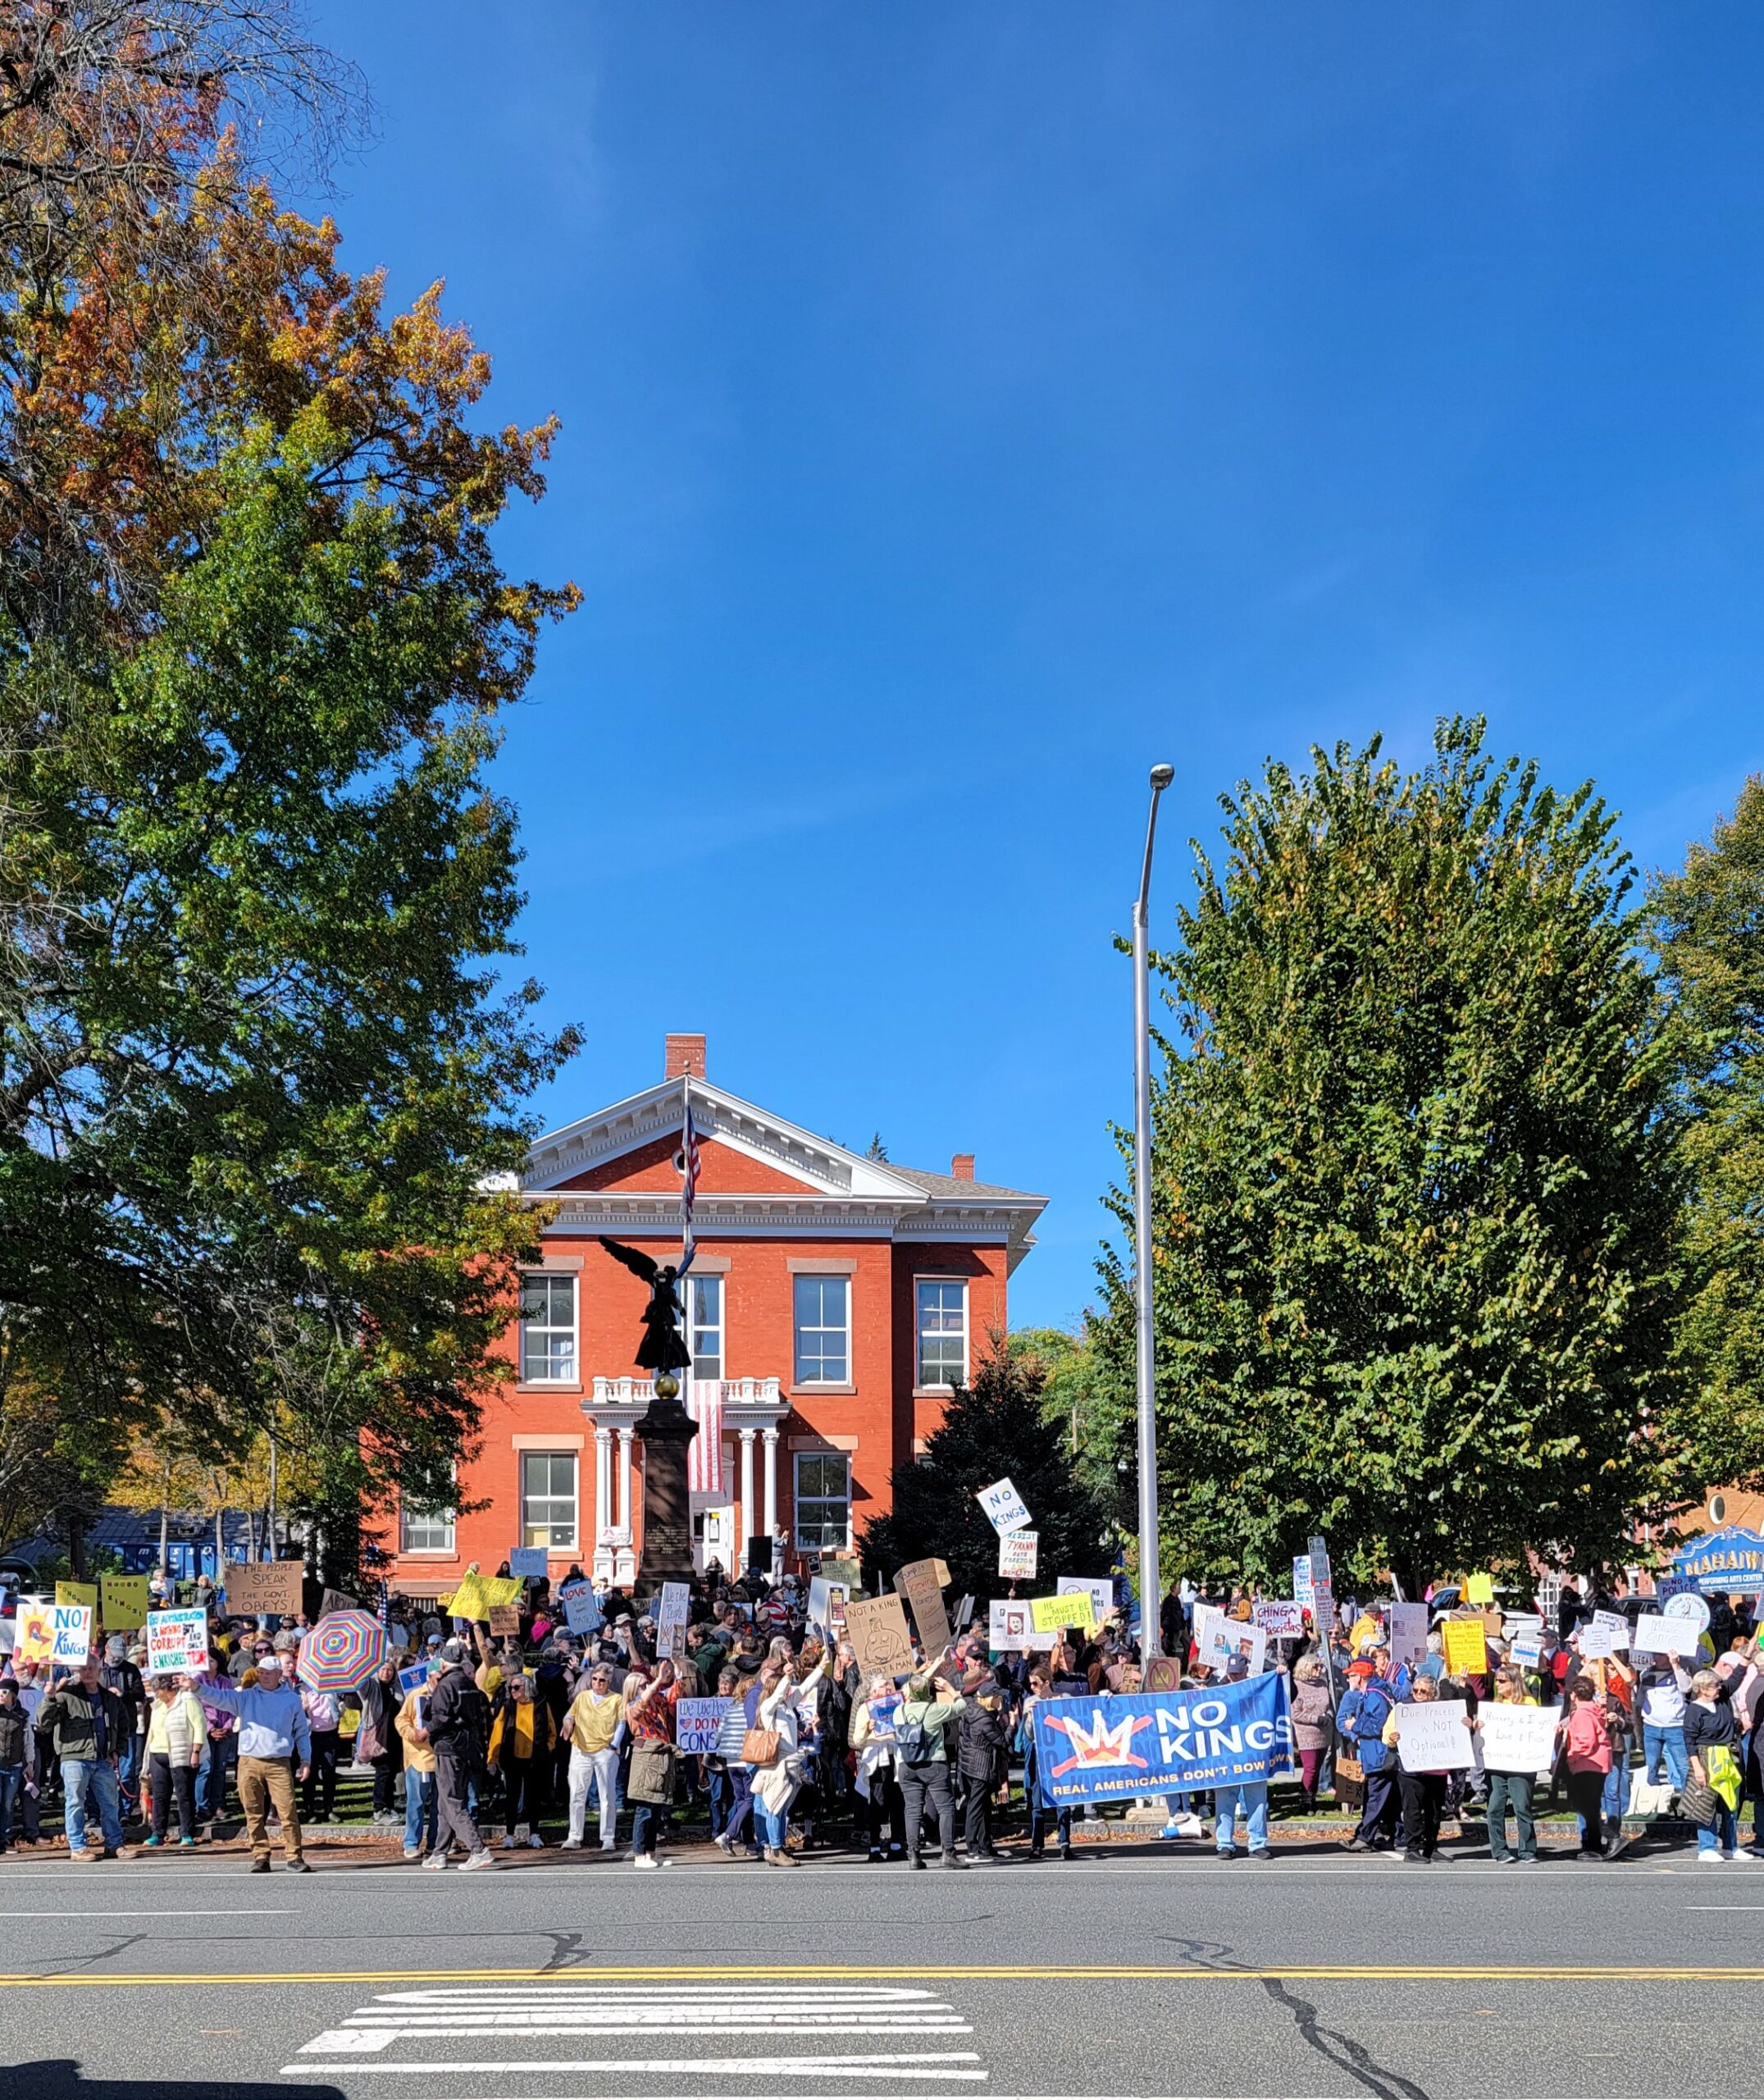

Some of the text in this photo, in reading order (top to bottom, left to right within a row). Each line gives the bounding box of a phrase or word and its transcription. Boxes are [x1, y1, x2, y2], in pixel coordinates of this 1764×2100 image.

[989, 1490, 1012, 1508] NO
[991, 1505, 1026, 1527] KINGS
[242, 1563, 295, 1574] THE PEOPLE
[1002, 1568, 1035, 1577] DOMESTIC
[251, 1573, 289, 1586] SPEAK
[1698, 1573, 1763, 1585] PERFORMING ARTS CENTER
[263, 1589, 291, 1598] GOVT.
[565, 1586, 586, 1600] LOVE
[1662, 1584, 1696, 1596] POLICE
[241, 1600, 296, 1613] OBEYS!
[848, 1598, 899, 1618] NOT A KING
[1044, 1602, 1090, 1614] HE MUST BE
[1042, 1611, 1092, 1627] STOPPED!
[151, 1628, 158, 1637] IS
[150, 1636, 185, 1651] CORRUPT
[153, 1651, 187, 1669] ENRICHES
[889, 1664, 895, 1672] A
[896, 1659, 913, 1669] MAN
[1215, 1655, 1228, 1669] TRU
[679, 1701, 695, 1717] We
[710, 1699, 735, 1716] Peo
[1401, 1705, 1455, 1718] Due Process
[1155, 1701, 1228, 1734] NO
[695, 1718, 709, 1731] DO
[1421, 1720, 1452, 1733] is NOT
[680, 1731, 721, 1752] CONS
[1160, 1714, 1292, 1764] KINGS
[1052, 1783, 1090, 1796] REAL
[1094, 1774, 1178, 1792] AMERICANS
[1183, 1766, 1228, 1781] DON'T
[1233, 1760, 1265, 1774] BOW
